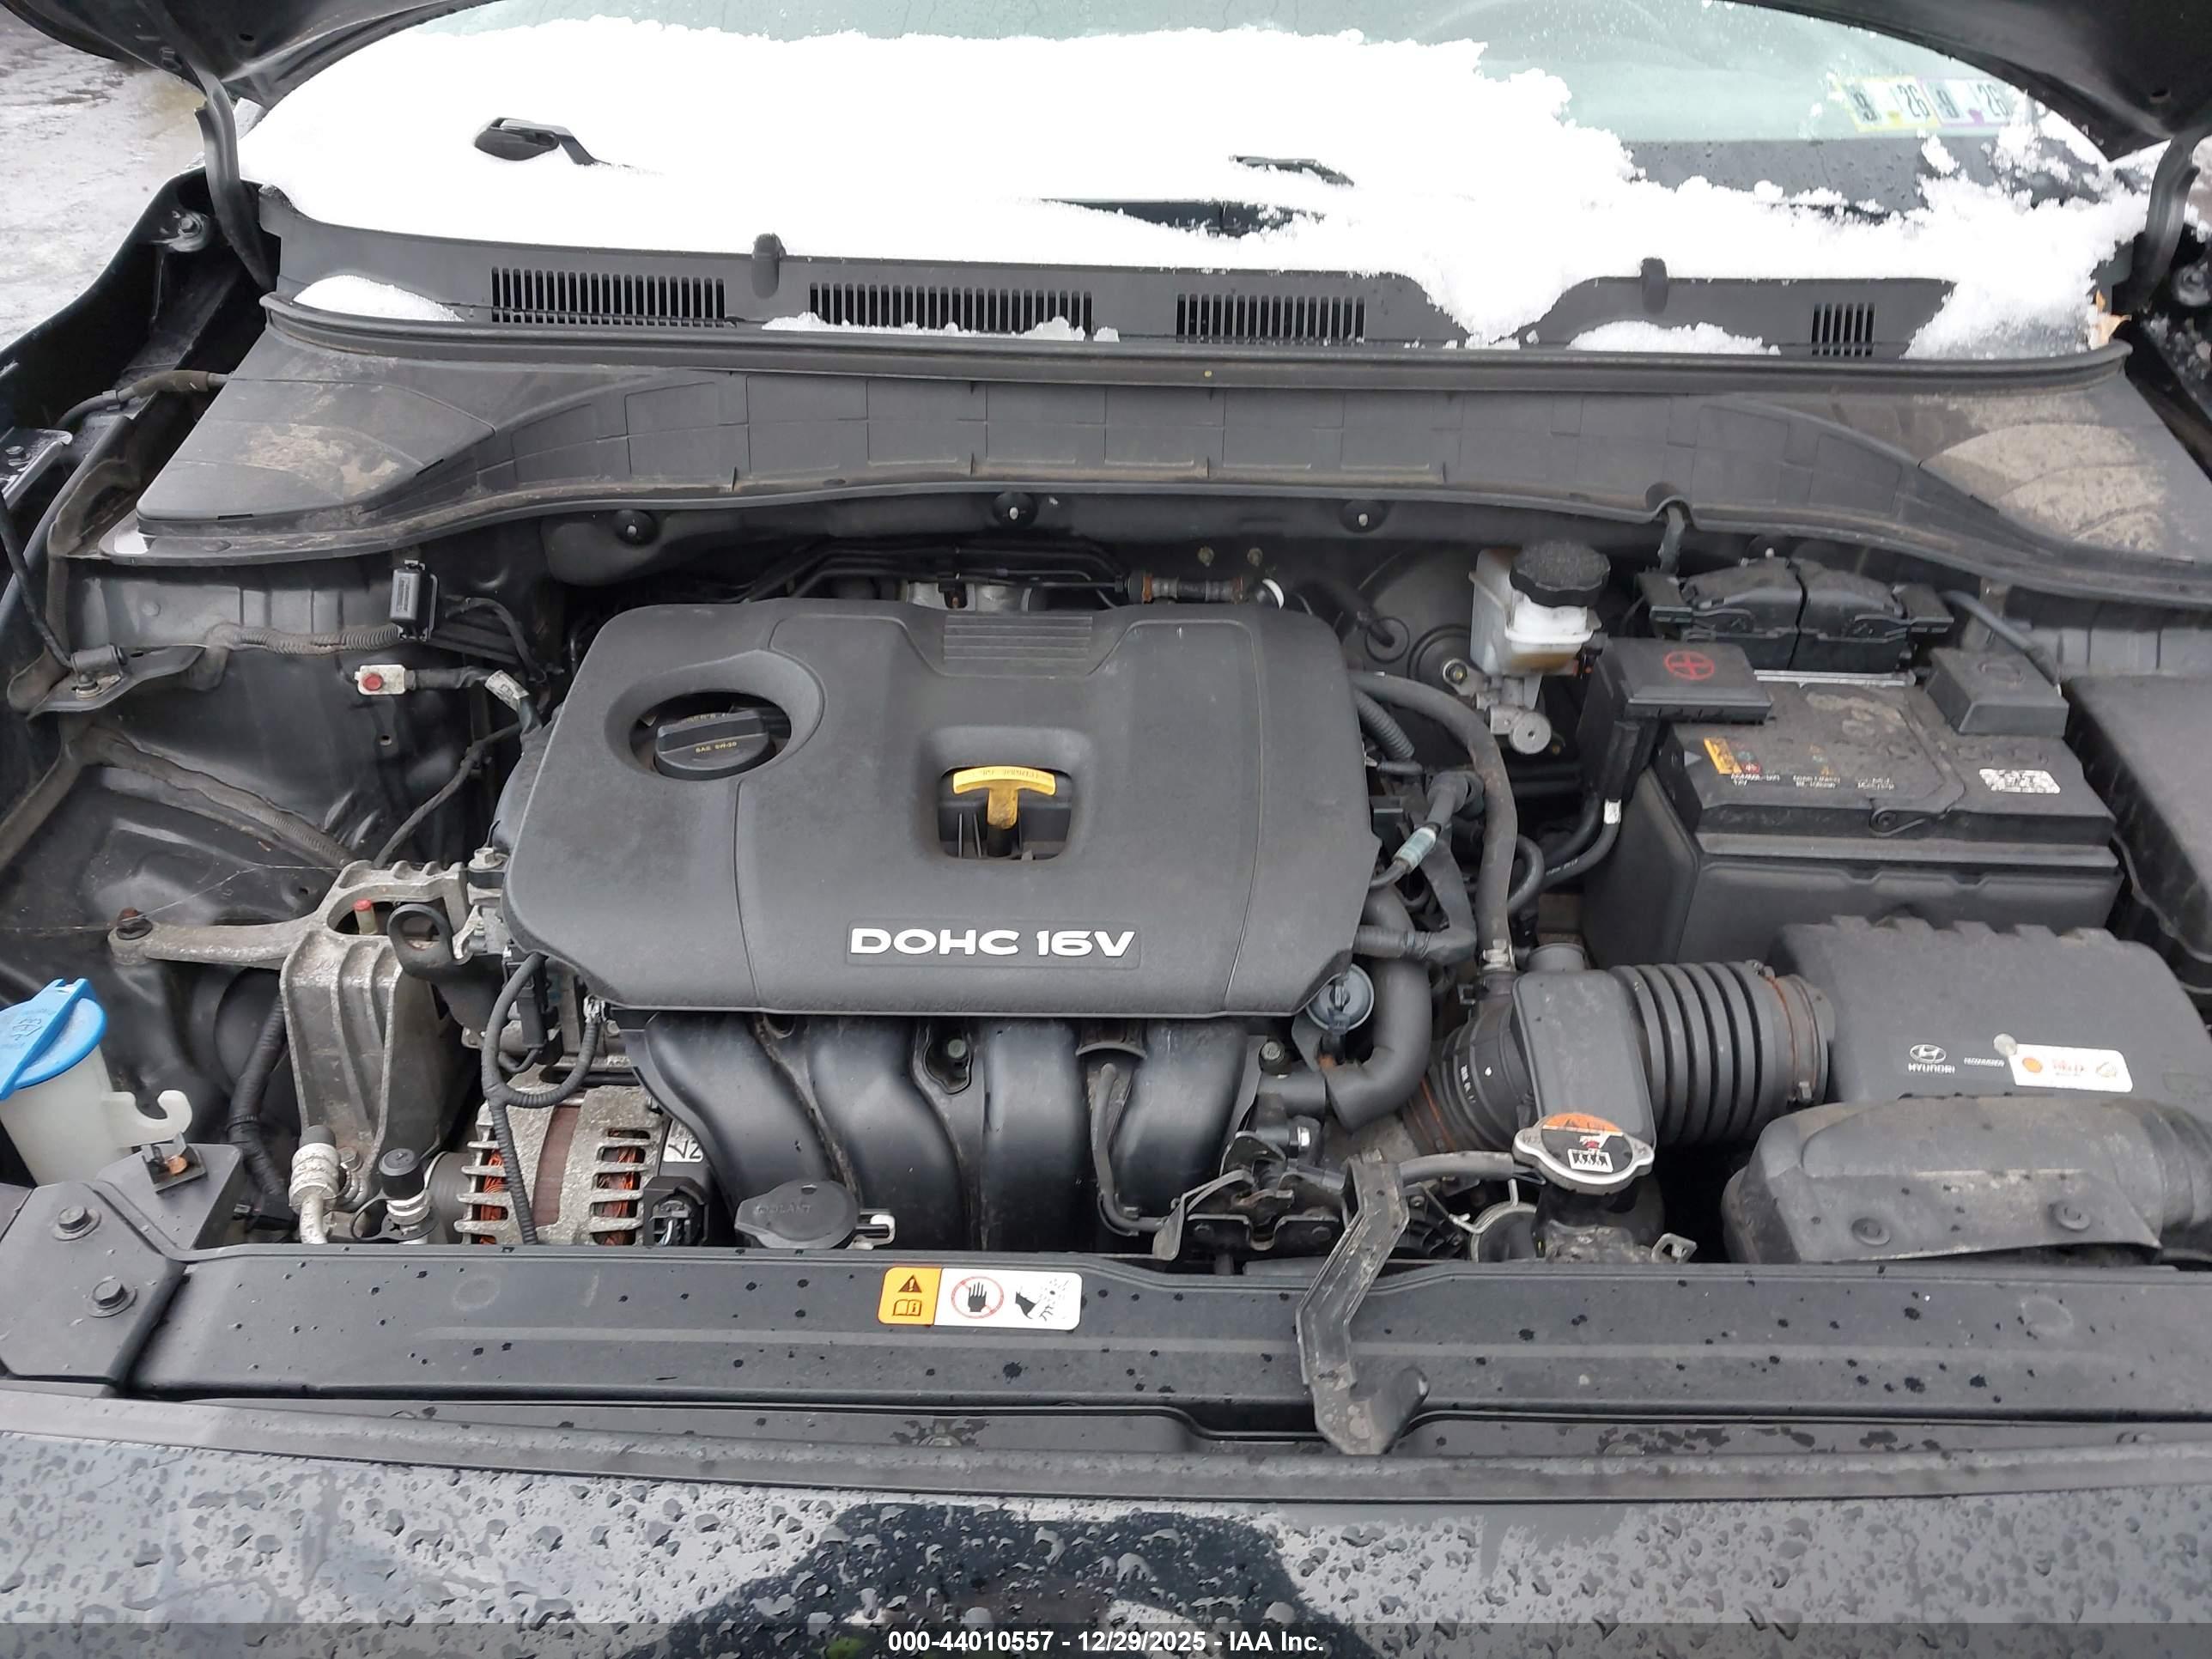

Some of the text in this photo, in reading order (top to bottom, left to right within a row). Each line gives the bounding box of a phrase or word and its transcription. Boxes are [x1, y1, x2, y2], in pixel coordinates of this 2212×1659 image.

[1896, 84, 1931, 118] 26
[1976, 83, 2013, 118] 26
[850, 927, 1136, 957] DOHC 16V
[1908, 1063, 1955, 1074] HYUNDAI
